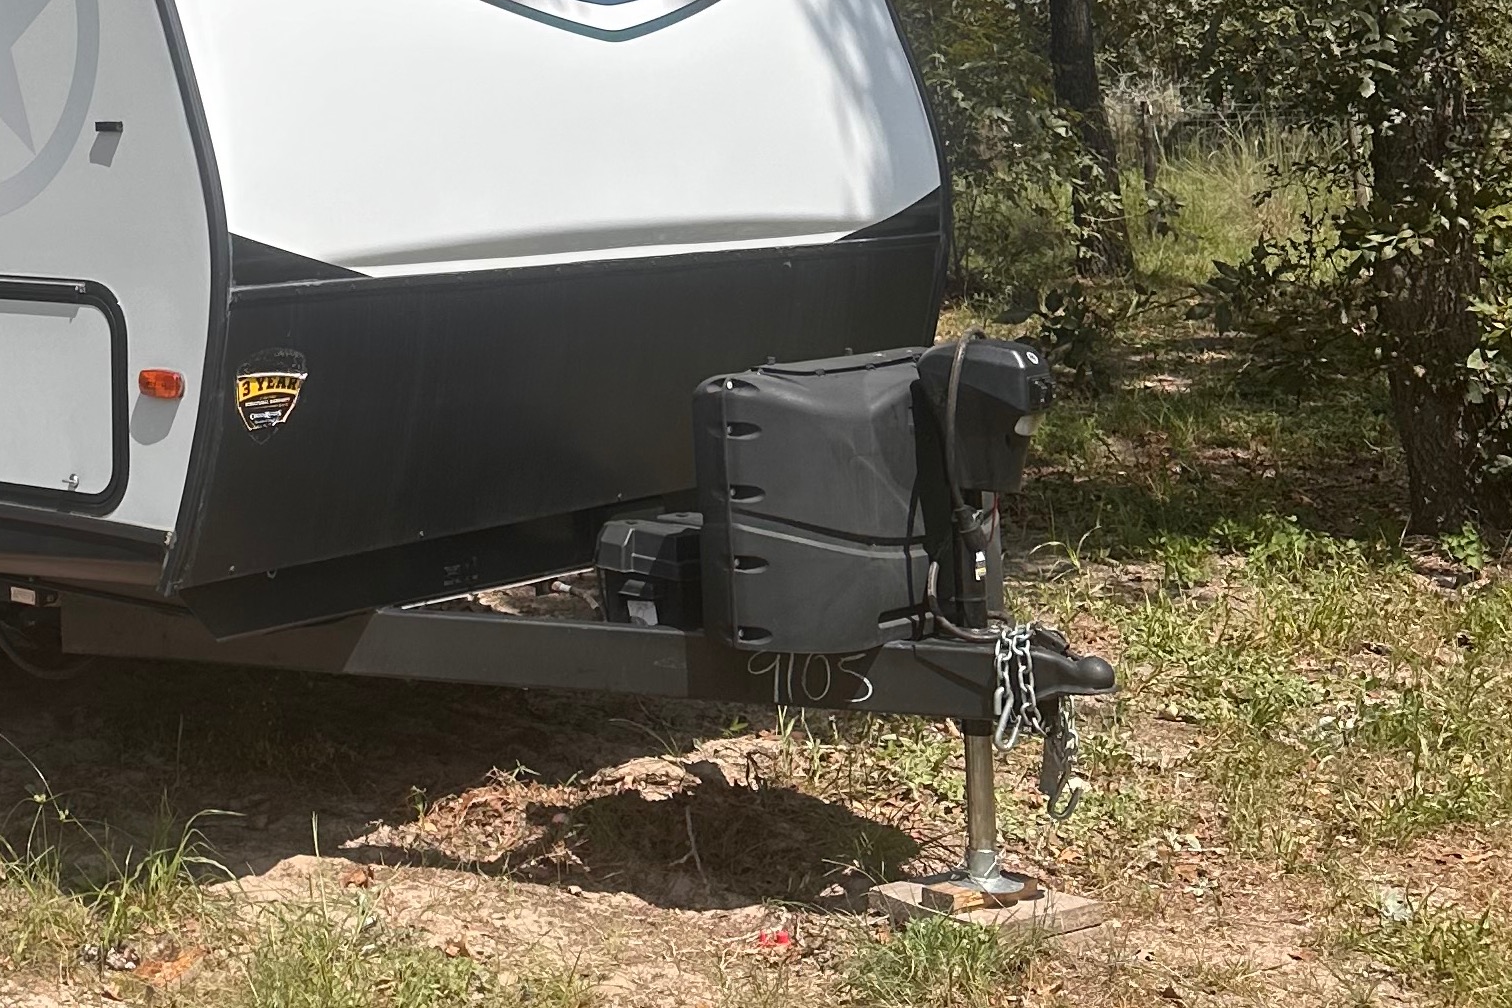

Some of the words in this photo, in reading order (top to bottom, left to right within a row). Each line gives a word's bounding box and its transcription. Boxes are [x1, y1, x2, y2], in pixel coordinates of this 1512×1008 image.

[242, 380, 251, 397] 3
[256, 376, 297, 391] YEAR
[748, 650, 873, 703] 9105
